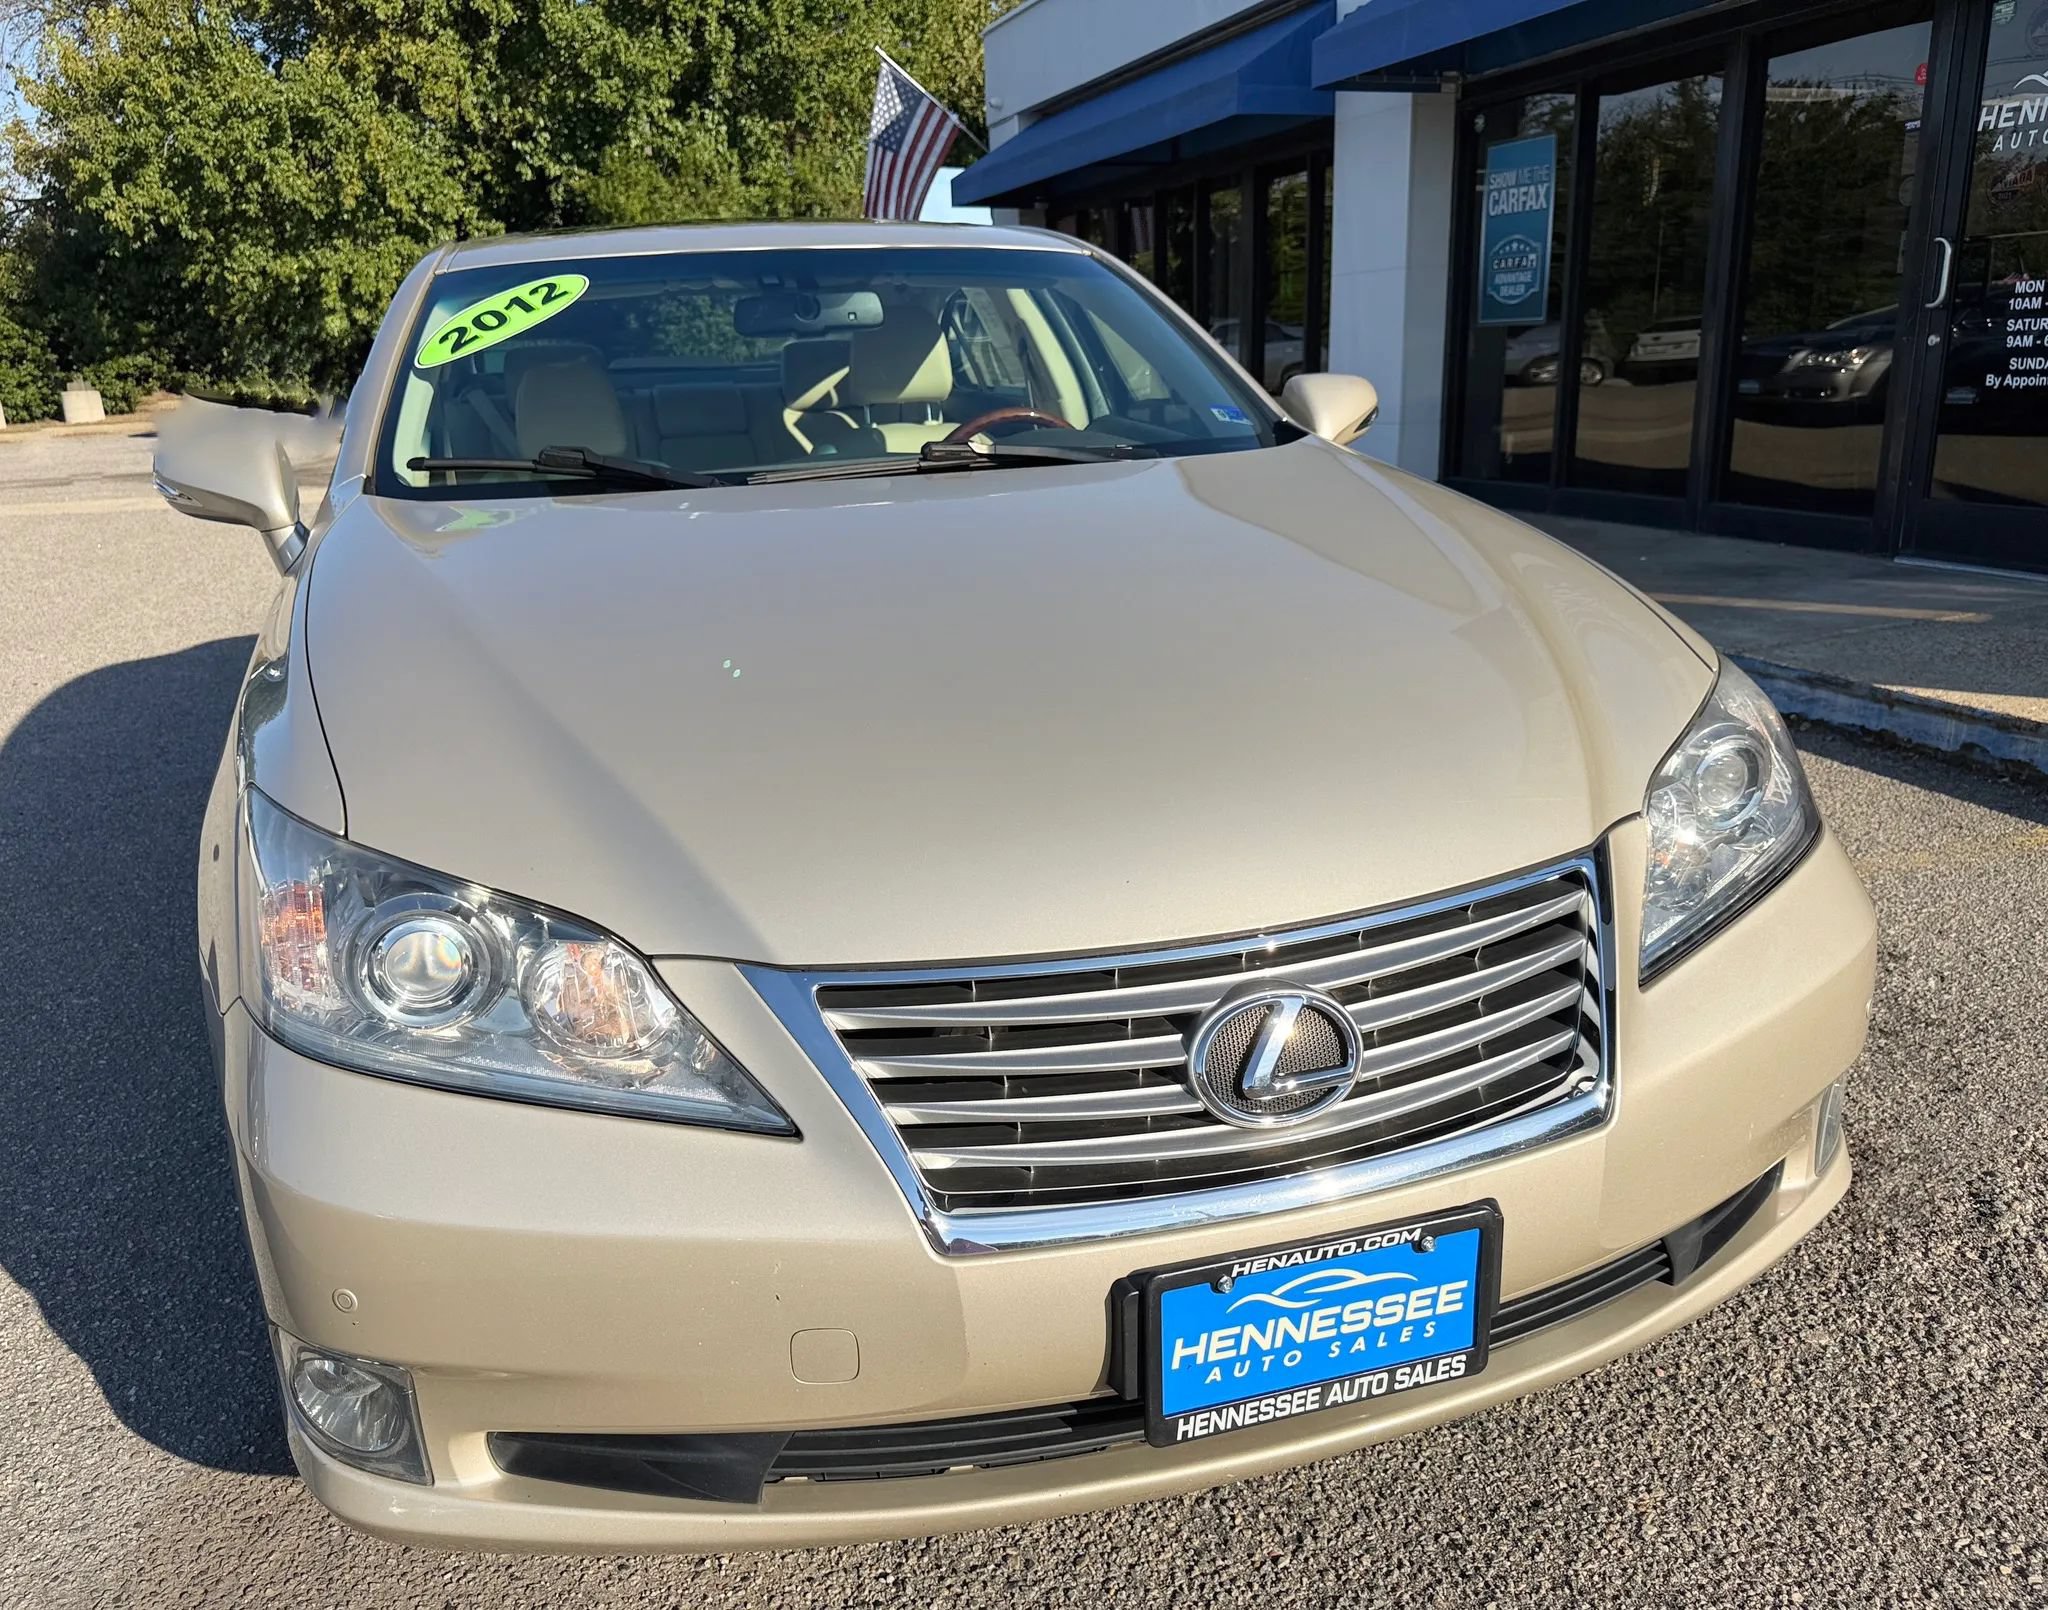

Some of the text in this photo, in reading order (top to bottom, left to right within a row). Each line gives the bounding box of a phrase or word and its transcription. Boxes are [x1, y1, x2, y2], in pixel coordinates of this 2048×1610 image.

[1490, 170, 1518, 190] SHOW
[1489, 183, 1550, 217] CARFAX
[1500, 284, 1525, 297] DEALER
[2014, 279, 2046, 294] MON
[2008, 296, 2042, 311] 10AM
[438, 282, 570, 355] 2012
[2006, 334, 2034, 348] 9AM
[1985, 373, 2048, 390] By Appoin
[1231, 1227, 1422, 1278] HENAUTO.COM
[1171, 1280, 1468, 1371] HENNESSEE
[1204, 1320, 1436, 1384] AUTO SALES
[1175, 1353, 1467, 1442] HENNESSEE AUTO SALES
